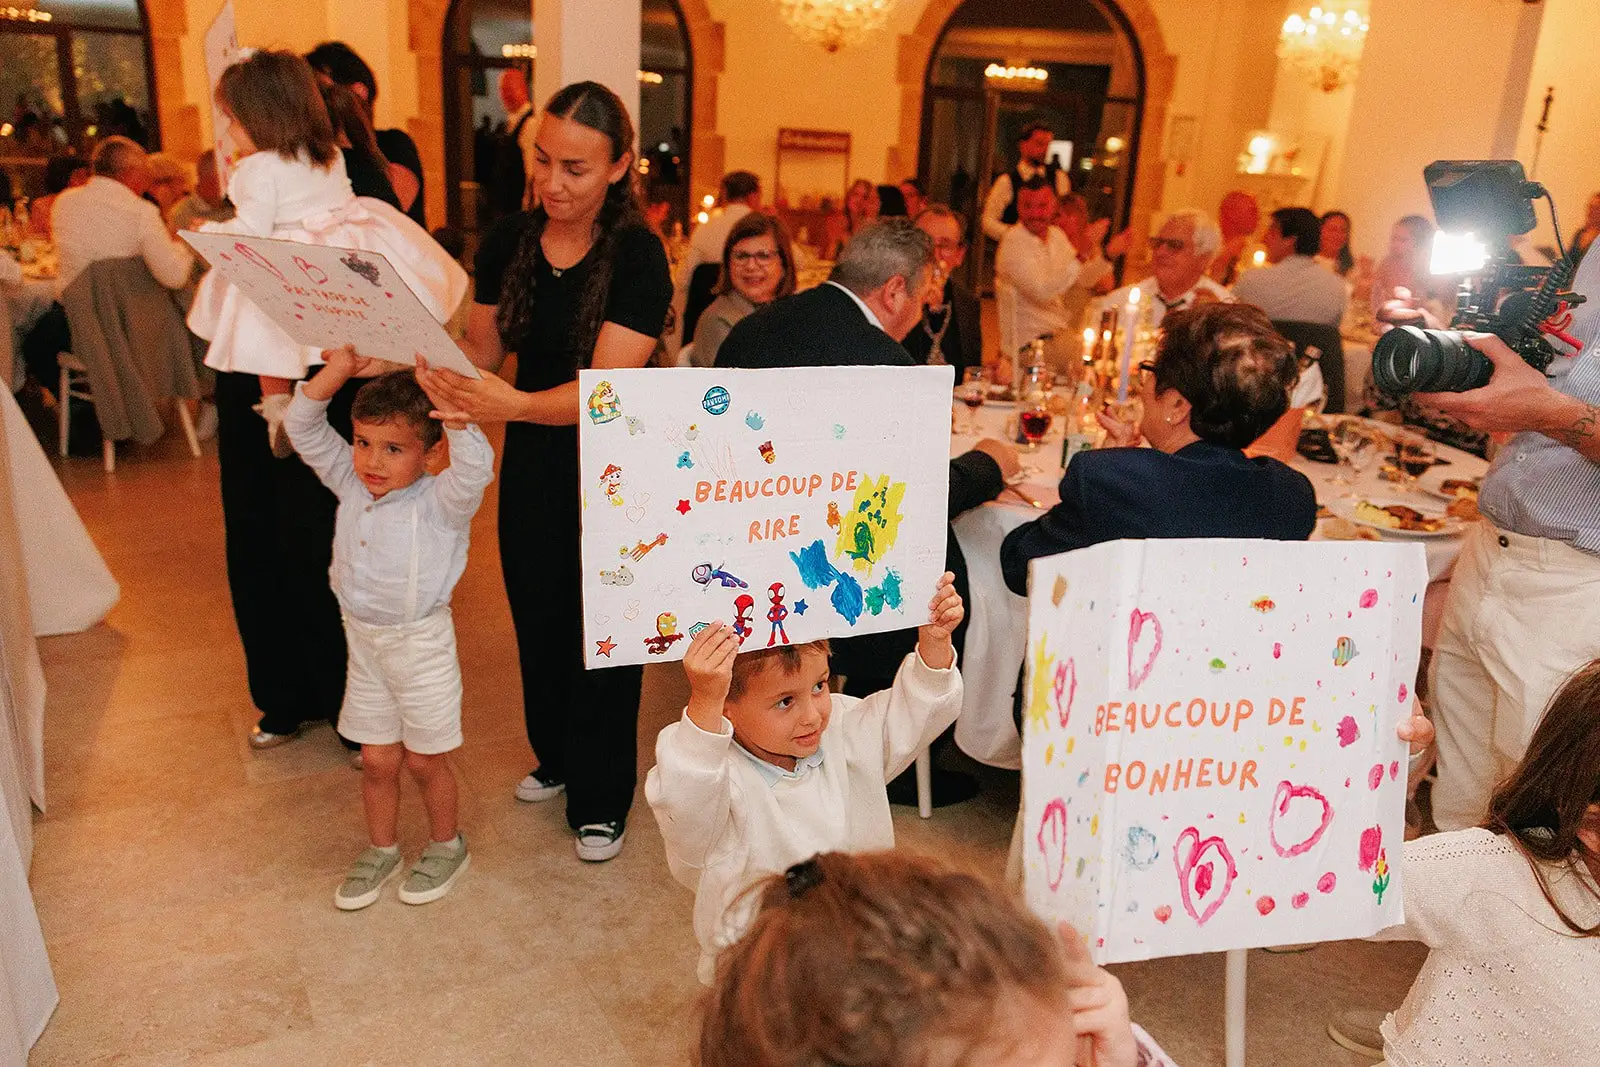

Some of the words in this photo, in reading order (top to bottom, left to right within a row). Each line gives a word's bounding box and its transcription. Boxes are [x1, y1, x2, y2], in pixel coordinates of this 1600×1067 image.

[311, 288, 347, 304] TROP
[350, 296, 370, 307] DE
[695, 474, 823, 504] BEAUCOUP
[831, 470, 858, 492] DE
[748, 514, 801, 544] RIRE
[1095, 697, 1255, 736] BEAUCOUP
[1267, 696, 1305, 726] DE
[1103, 758, 1259, 796] BONHEUR
